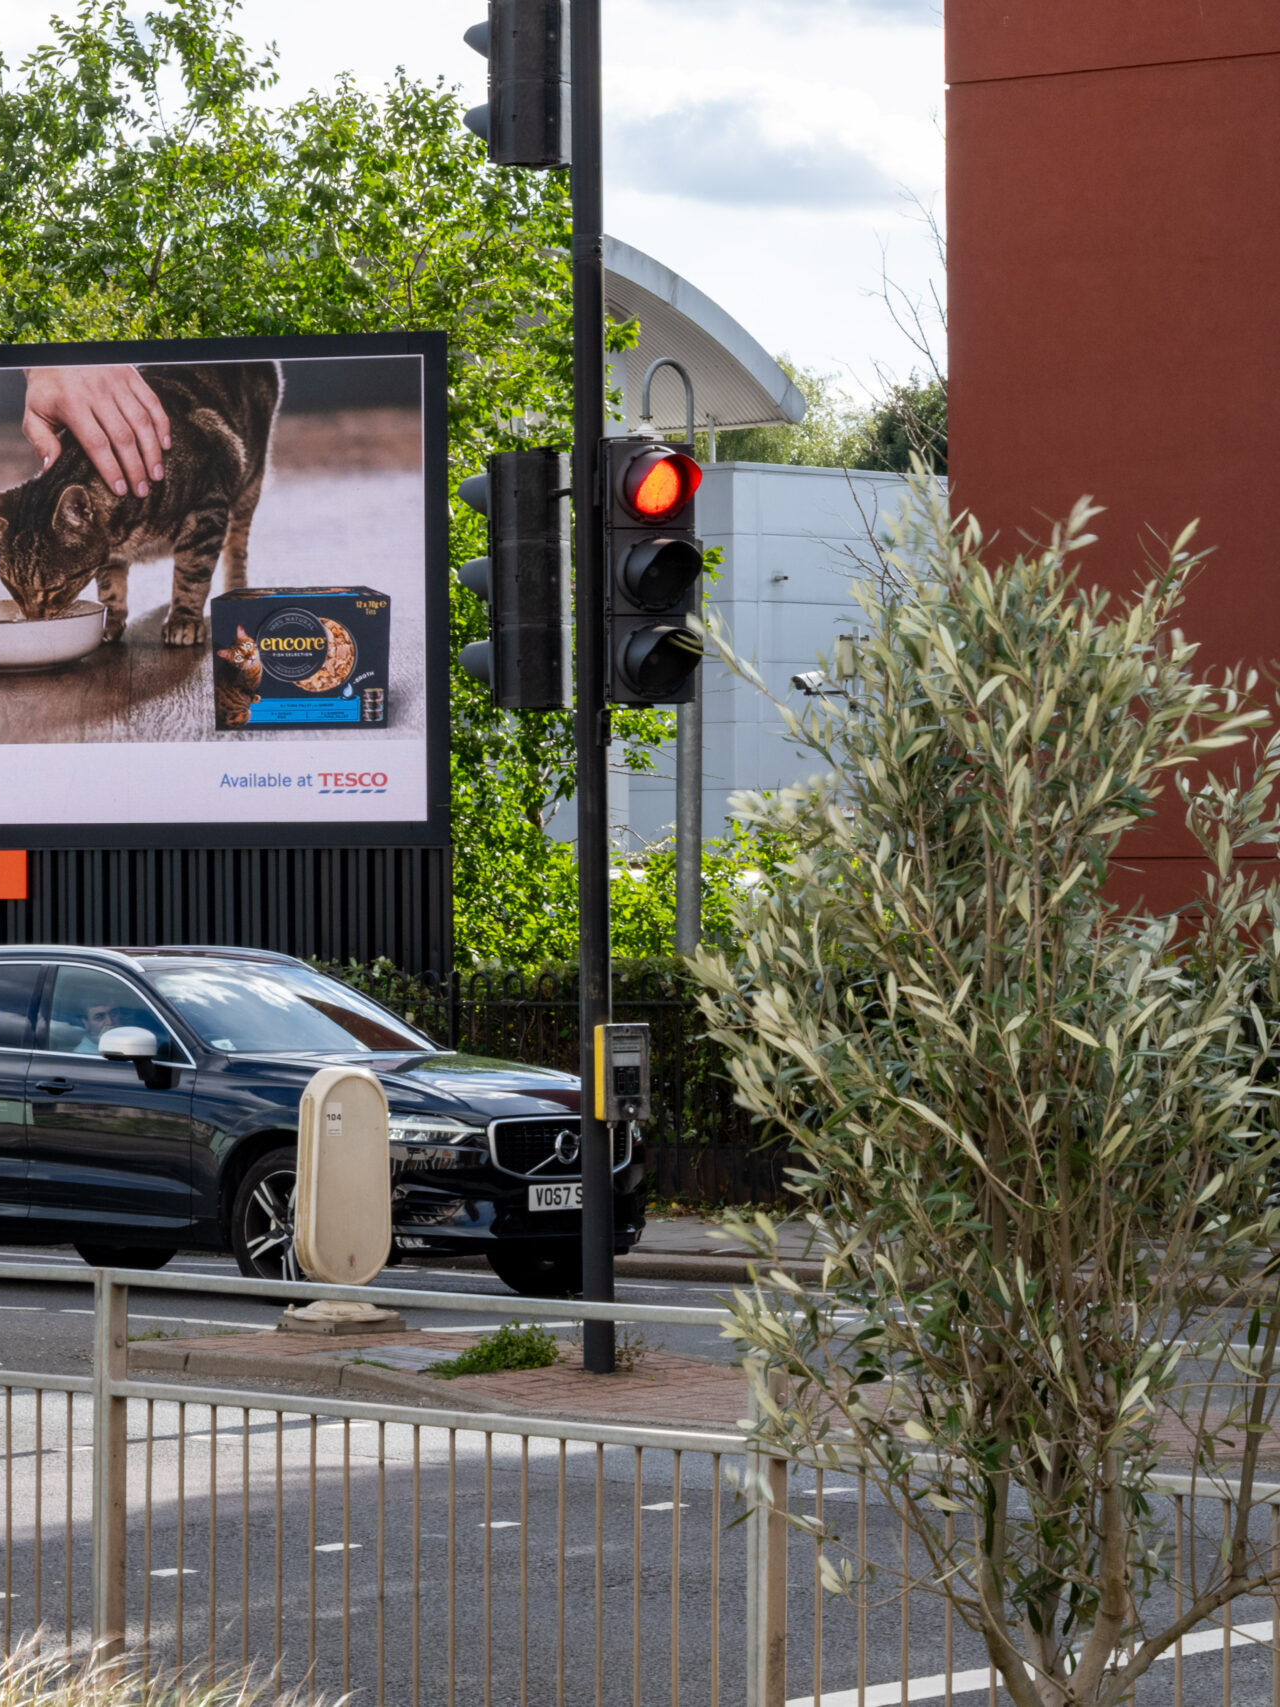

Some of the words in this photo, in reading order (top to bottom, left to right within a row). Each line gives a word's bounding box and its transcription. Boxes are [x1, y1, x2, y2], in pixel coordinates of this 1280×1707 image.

[220, 773, 292, 788] Available
[297, 773, 313, 788] at
[318, 772, 388, 787] TESCO
[326, 1113, 341, 1121] 104
